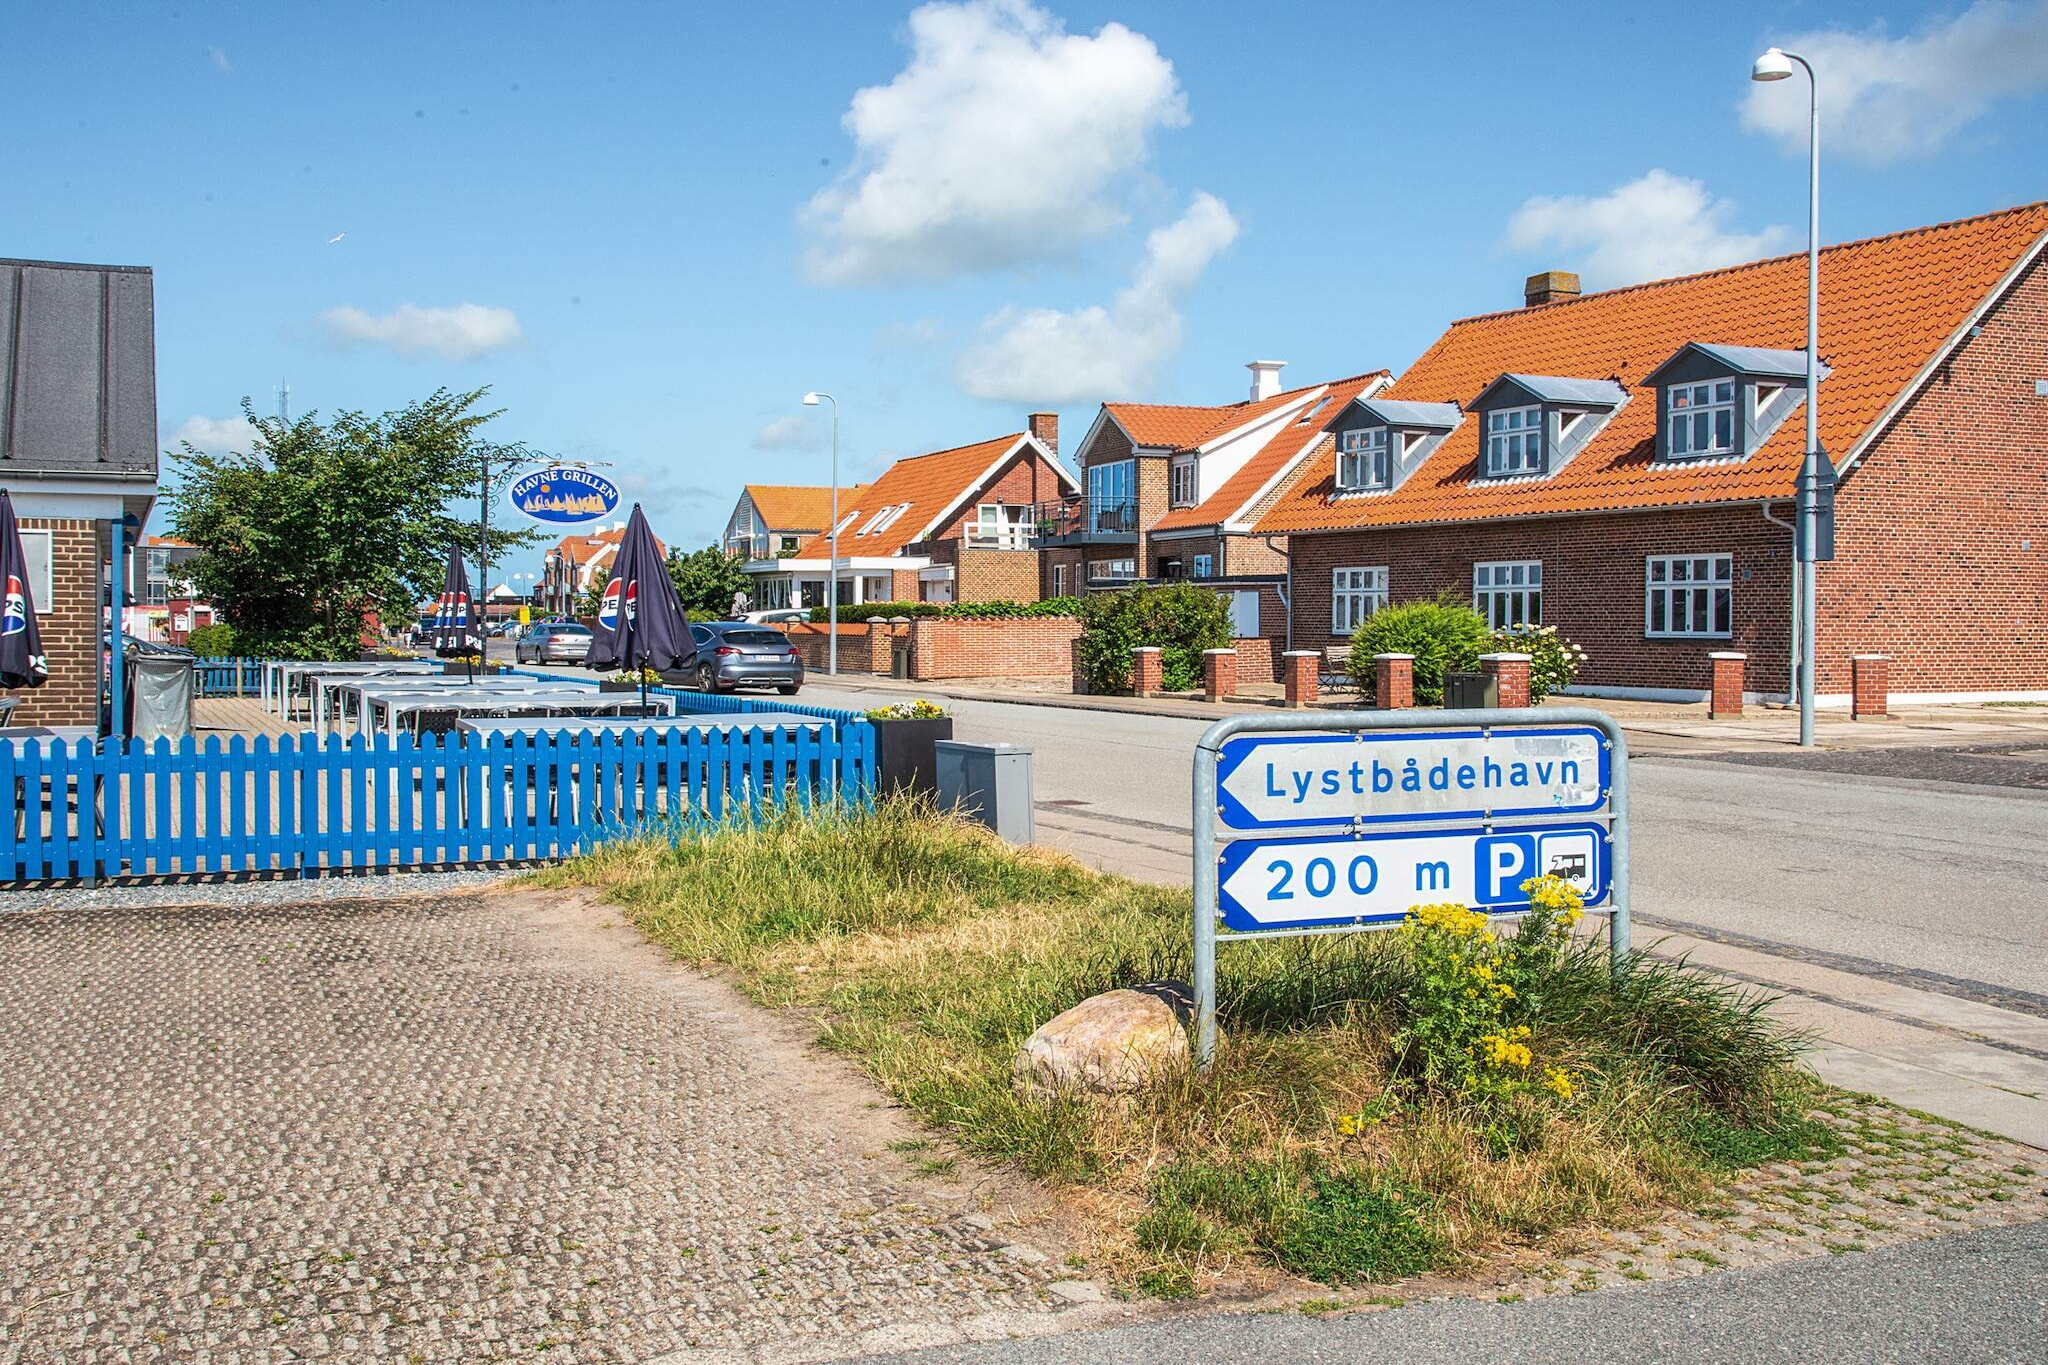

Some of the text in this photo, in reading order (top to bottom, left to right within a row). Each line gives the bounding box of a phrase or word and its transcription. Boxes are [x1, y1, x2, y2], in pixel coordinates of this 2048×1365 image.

[514, 470, 617, 501] HAVNE GRILLEN
[1266, 755, 1579, 804] Lystbådehavn
[1266, 842, 1525, 901] 200 m P
